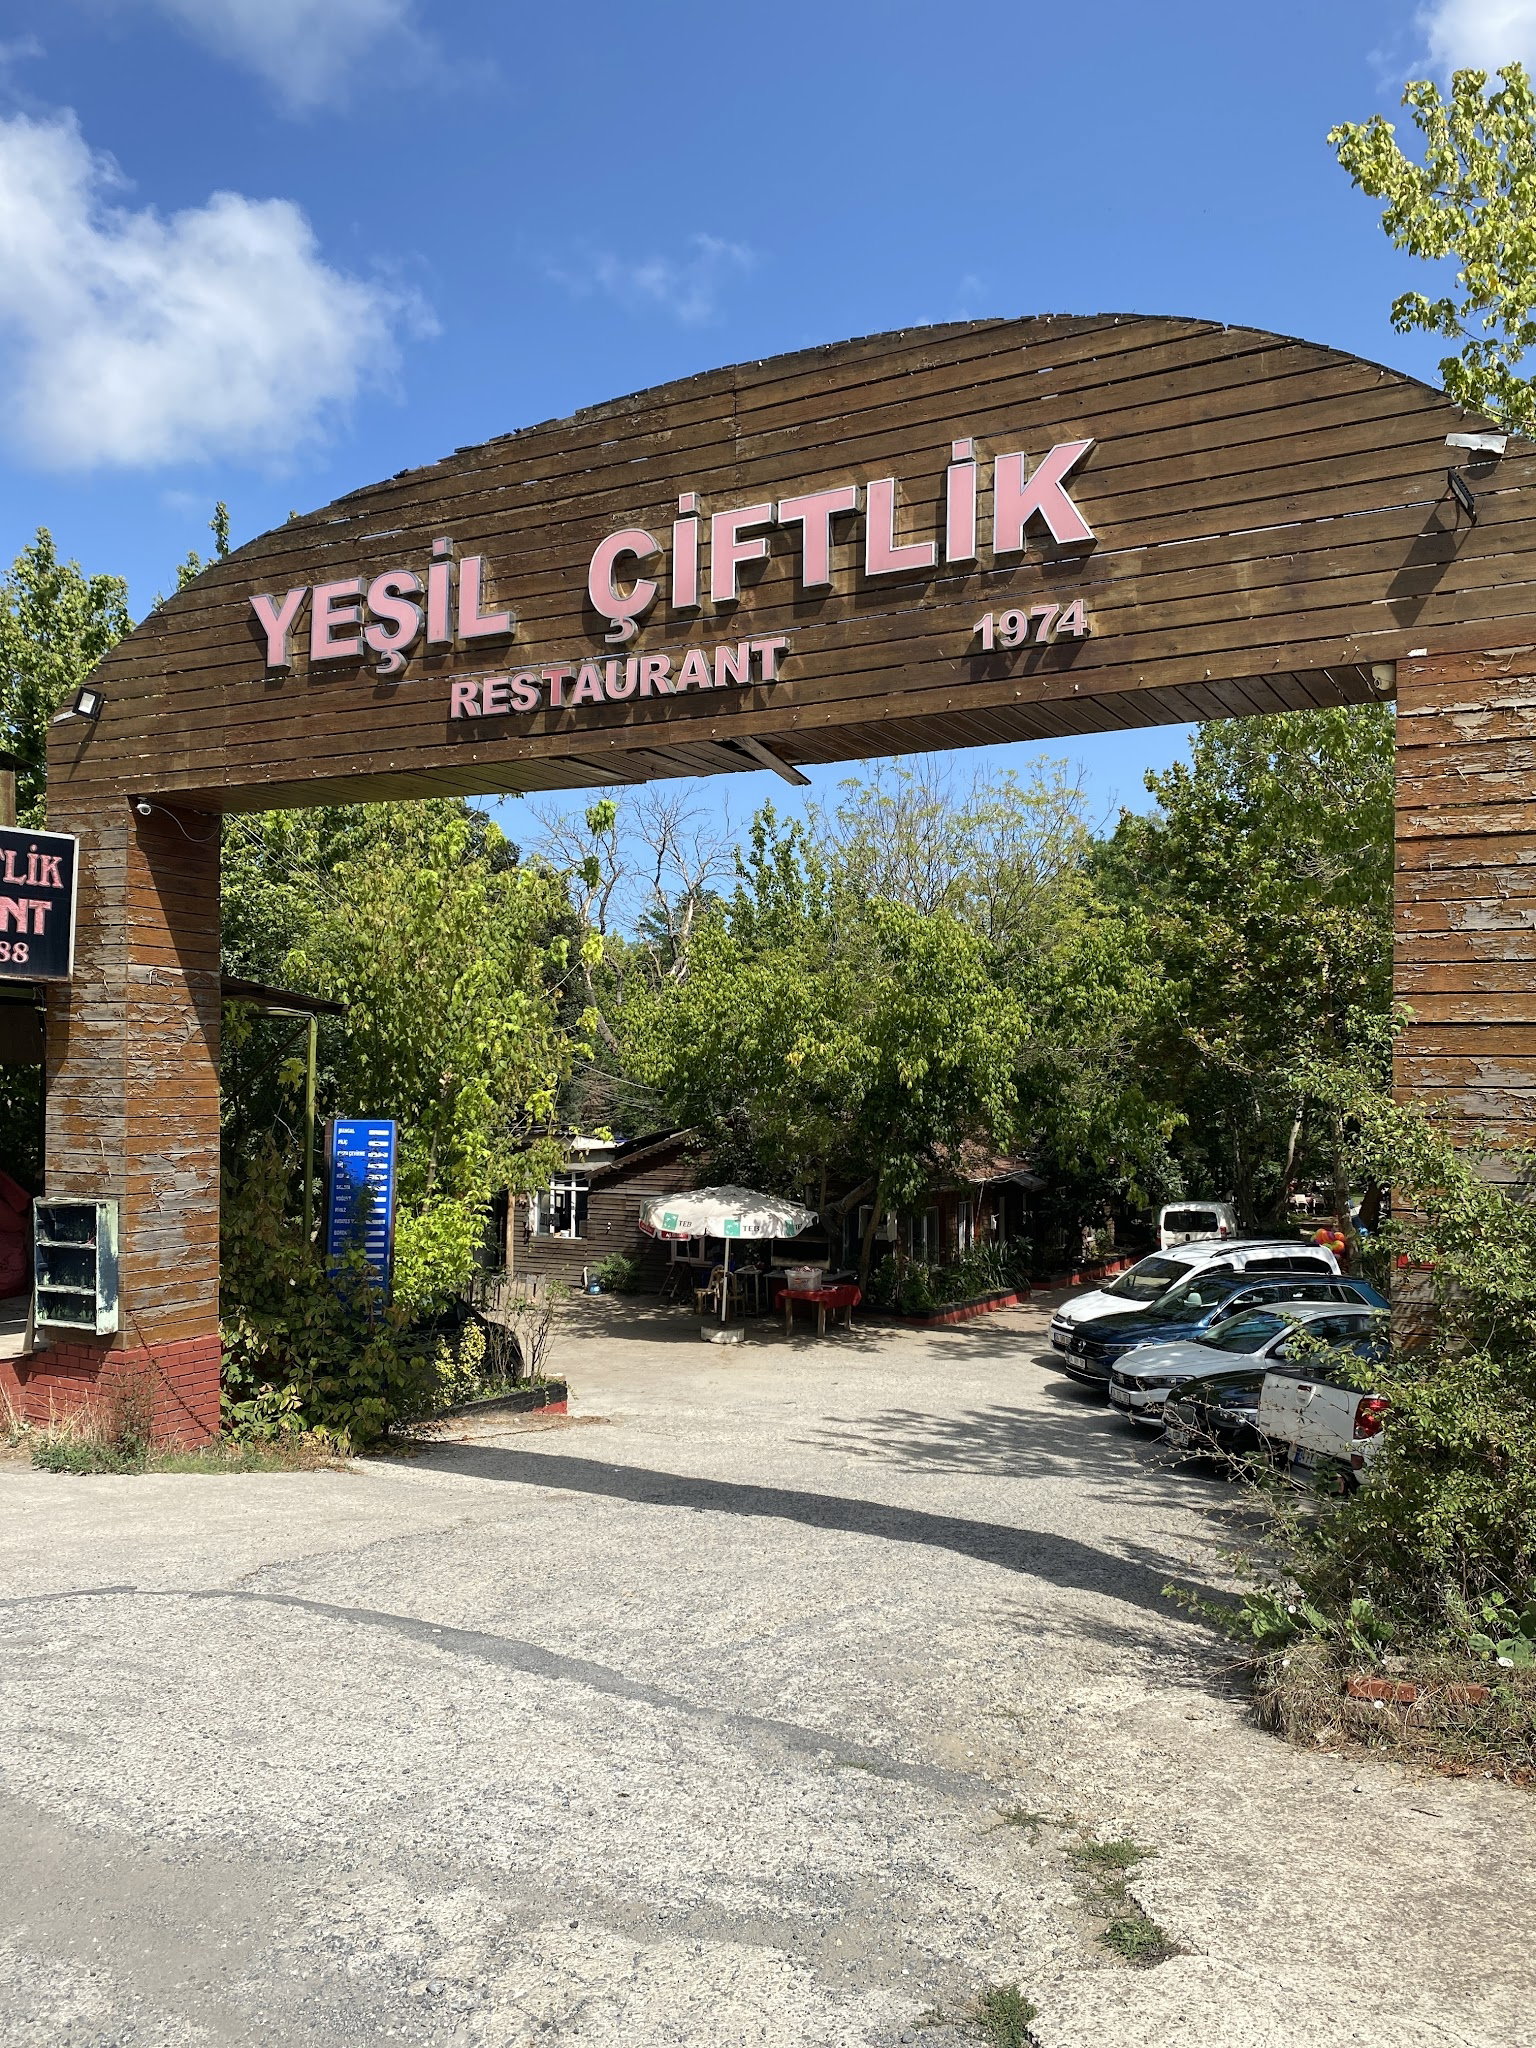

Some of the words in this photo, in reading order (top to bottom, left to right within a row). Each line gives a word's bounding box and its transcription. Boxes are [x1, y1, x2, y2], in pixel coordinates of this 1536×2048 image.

[249, 536, 515, 674] YEŞİL
[588, 437, 1098, 644] ÇİFTLİK
[973, 599, 1092, 651] 1974
[450, 636, 791, 719] RESTAURANT
[678, 1220, 693, 1228] TEB
